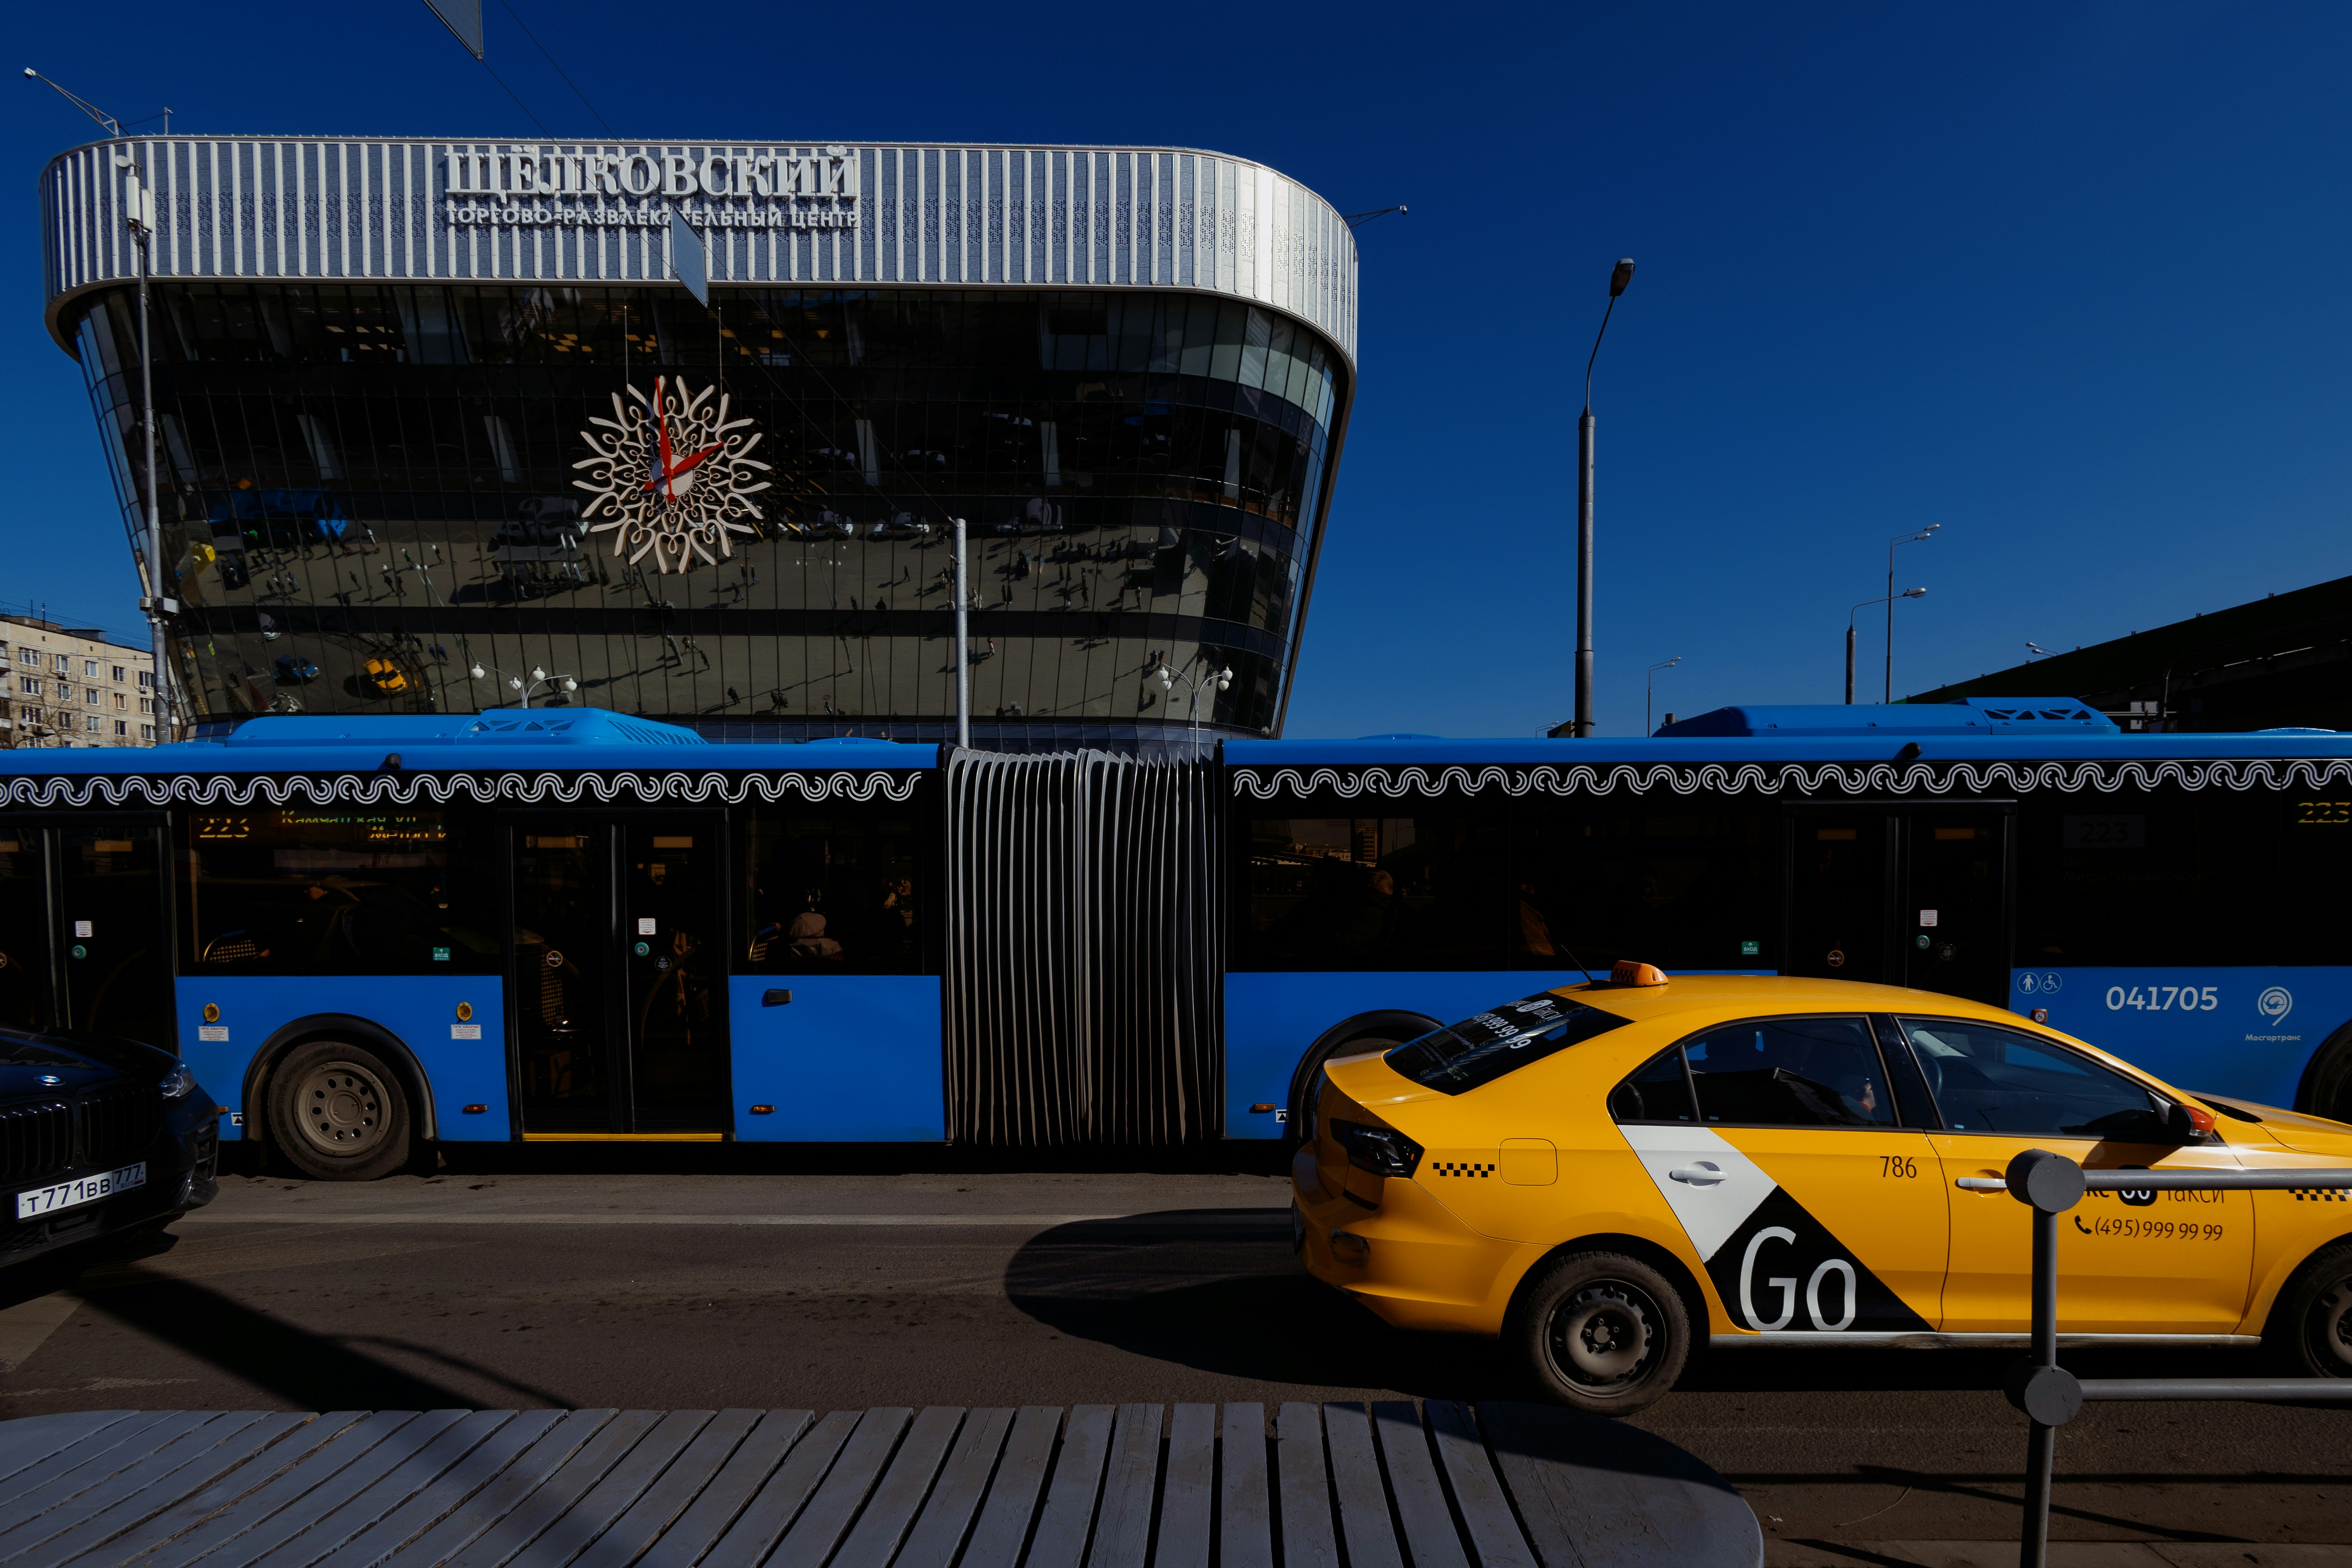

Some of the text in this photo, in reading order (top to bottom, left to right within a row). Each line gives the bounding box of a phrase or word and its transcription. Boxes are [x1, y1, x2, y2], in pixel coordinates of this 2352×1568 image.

[444, 145, 857, 204] ЩЁЛКОВСКИЙ
[792, 211, 858, 228] ЦЕНТР
[2298, 802, 2351, 823] 223
[2080, 823, 2128, 842] 223
[2063, 871, 2108, 884] Метро
[2106, 986, 2218, 1010] 041705
[1482, 1017, 1509, 1029] 999
[1495, 1025, 1519, 1037] 99
[1505, 1034, 1532, 1049] 99
[2245, 1033, 2301, 1042] Мосгортранс
[114, 1164, 141, 1185] 777
[1880, 1156, 1917, 1178] 786
[2095, 1216, 2223, 1241] (495) 999 99 99
[1740, 1226, 1856, 1331] Go
